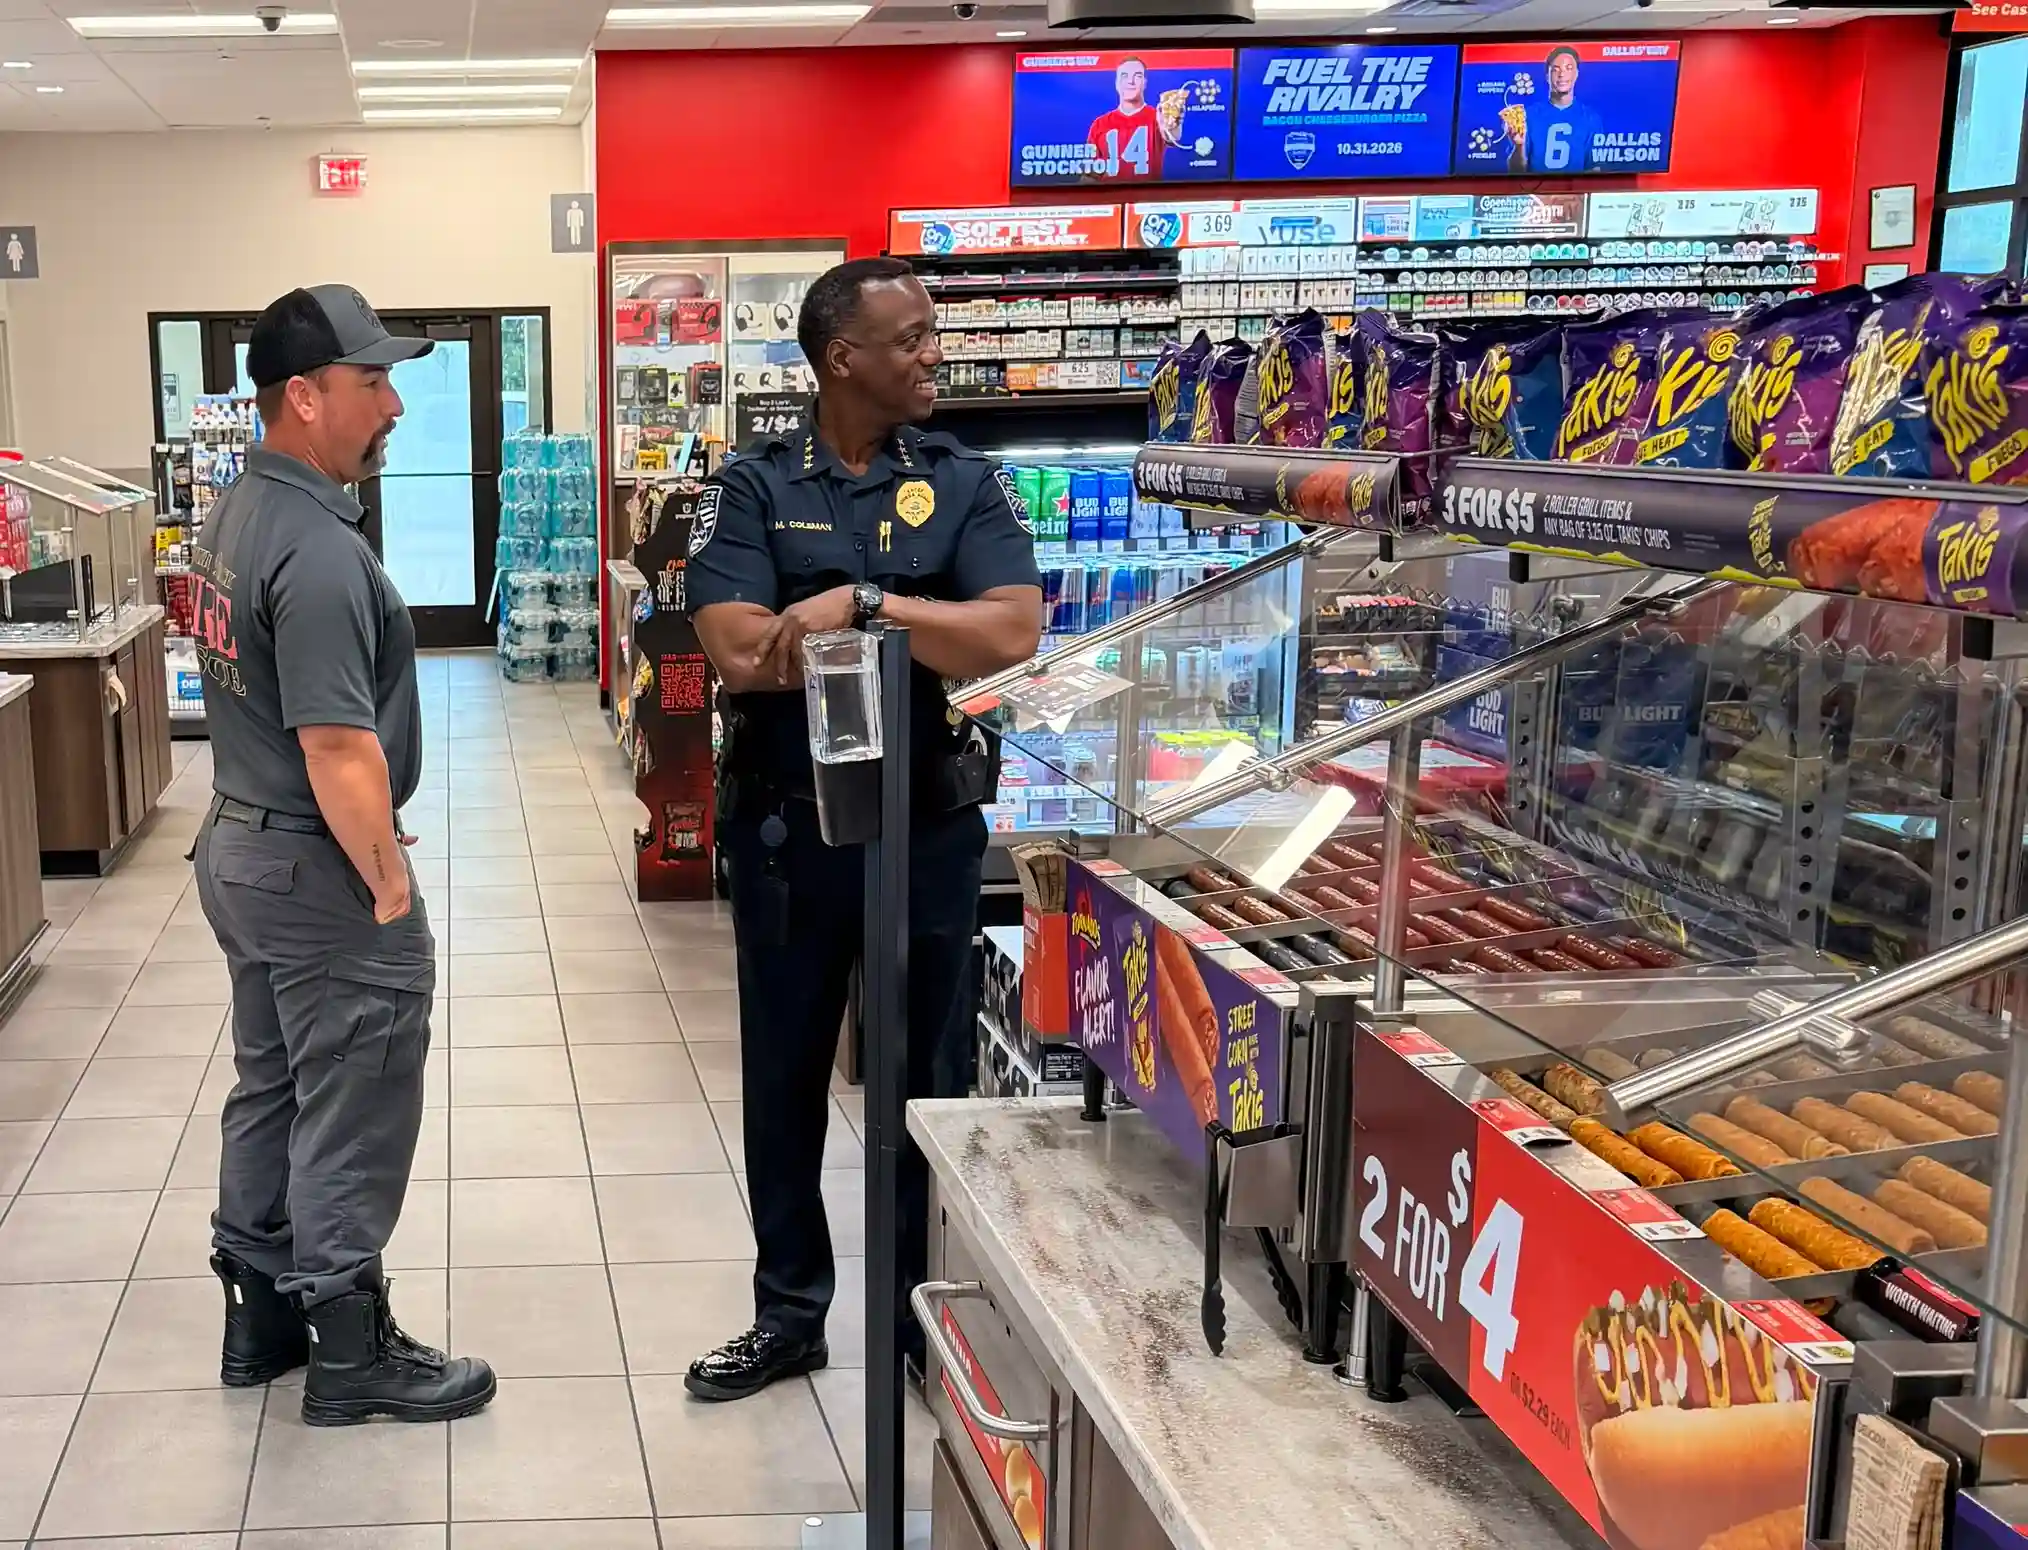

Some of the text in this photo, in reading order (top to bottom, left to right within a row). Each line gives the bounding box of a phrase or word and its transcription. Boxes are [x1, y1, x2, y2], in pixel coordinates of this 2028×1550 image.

[1972, 2, 1998, 16] See
[1263, 56, 1434, 85] FUEL THE
[1265, 83, 1428, 112] RIVALRY
[1394, 112, 1428, 124] PIZZA
[1021, 143, 1098, 160] GUNNER
[1105, 125, 1150, 177] 14
[1544, 122, 1573, 169] 6
[1591, 147, 1661, 163] WILSON
[1592, 132, 1662, 147] DALLAS
[953, 218, 1073, 237] SOFTEST
[1137, 462, 1146, 490] 3
[1146, 463, 1167, 493] FOR
[1167, 462, 1184, 496] $5
[1442, 484, 1537, 535] 3 FOR $5
[1543, 494, 1633, 521] 2 ROLLER GRILL ITEMS &
[788, 520, 833, 532] COLEMAN
[1543, 517, 1559, 536] ANY
[1559, 519, 1576, 538] BAG
[1575, 520, 1586, 539] OF
[1586, 521, 1604, 541] 3.25
[1644, 527, 1671, 550] CHIPS
[1936, 519, 2000, 594] Takis
[1469, 706, 1505, 736] LIGHT
[1623, 704, 1683, 721] LIGHT
[1074, 955, 1110, 1013] FLAVOR
[1082, 999, 1115, 1050] ALERT!
[1227, 1000, 1258, 1036] STREET
[1227, 1037, 1249, 1069] CORN
[1229, 1077, 1265, 1133] Takis
[1359, 1155, 1389, 1262] 2
[1391, 1186, 1453, 1323] FOR
[1885, 1281, 1958, 1341] WORTH WAITING
